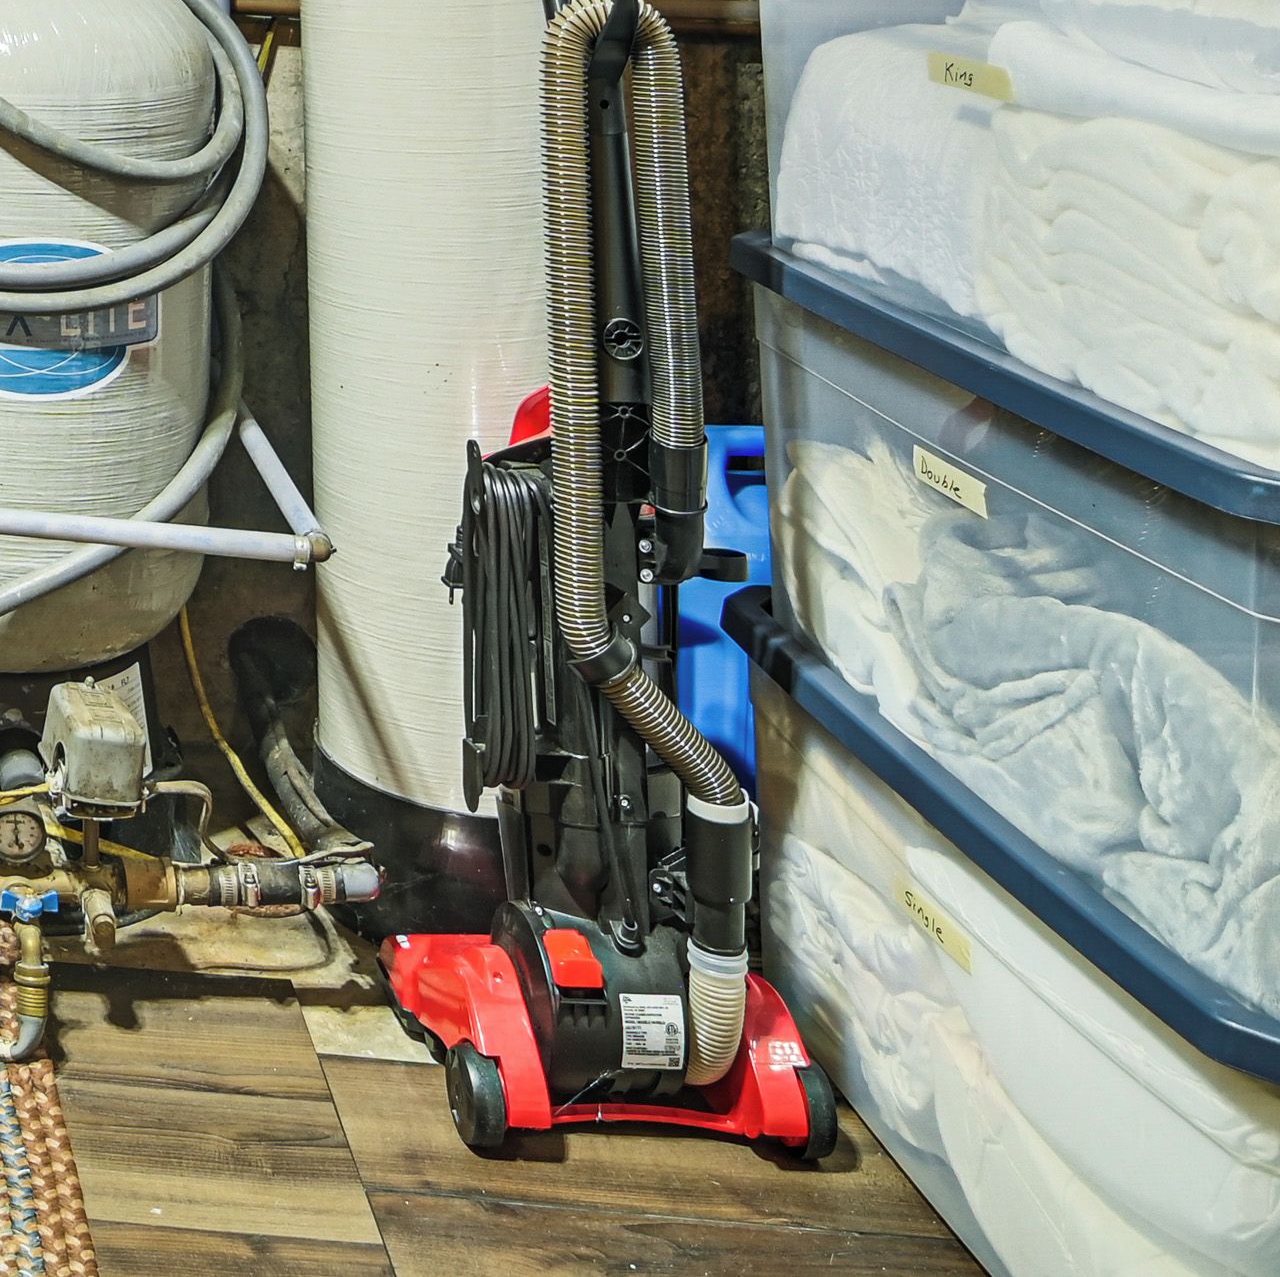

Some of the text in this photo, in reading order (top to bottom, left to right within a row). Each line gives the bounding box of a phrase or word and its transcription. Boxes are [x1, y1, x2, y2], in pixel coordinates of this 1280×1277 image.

[943, 61, 975, 88] King
[920, 454, 963, 500] Double
[904, 890, 945, 945] Single
